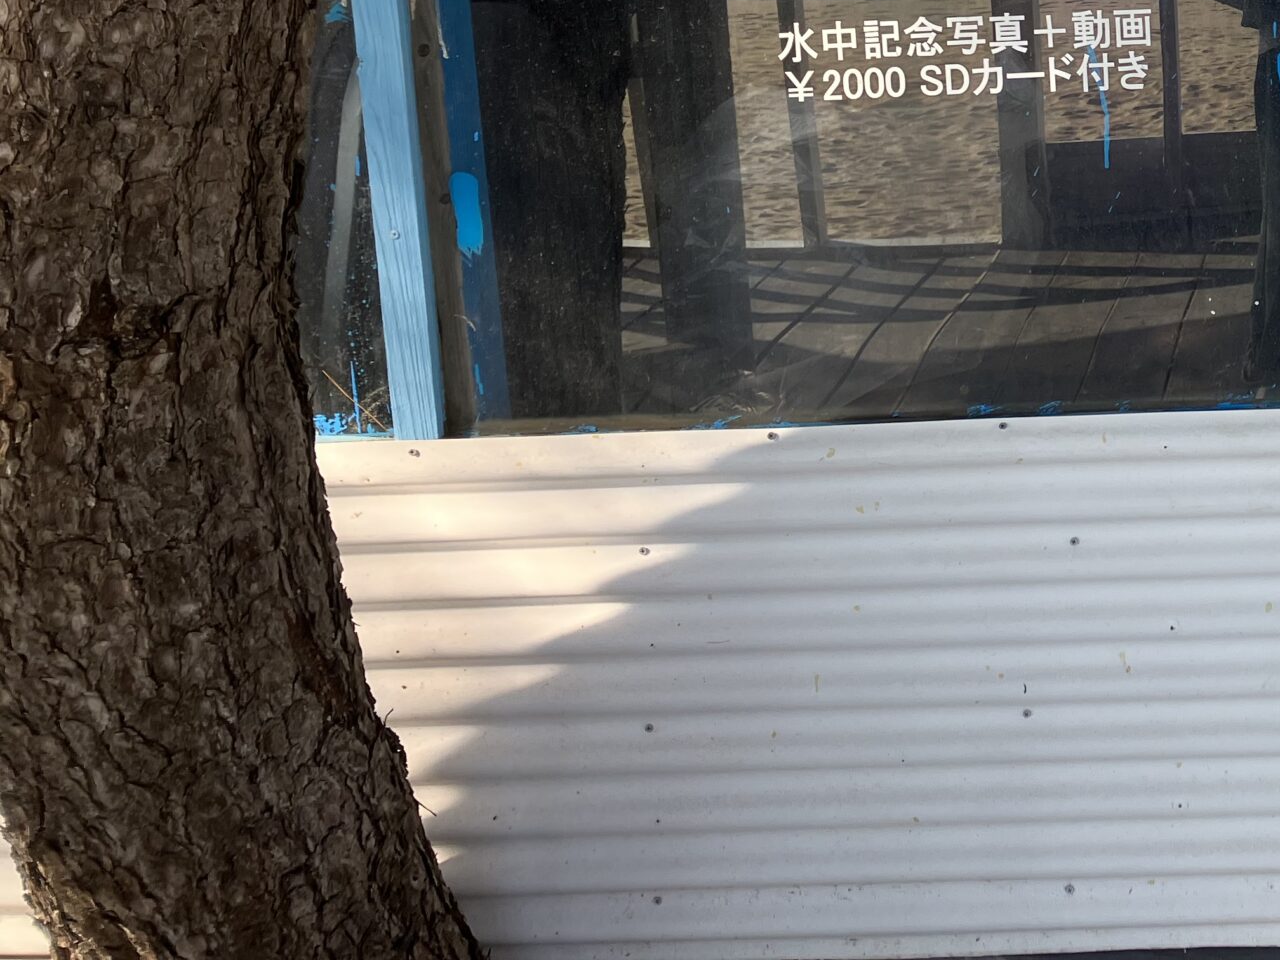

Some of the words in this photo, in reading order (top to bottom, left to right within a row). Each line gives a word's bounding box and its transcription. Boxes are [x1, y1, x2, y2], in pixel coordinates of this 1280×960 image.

[920, 50, 1149, 96] SDカード付き
